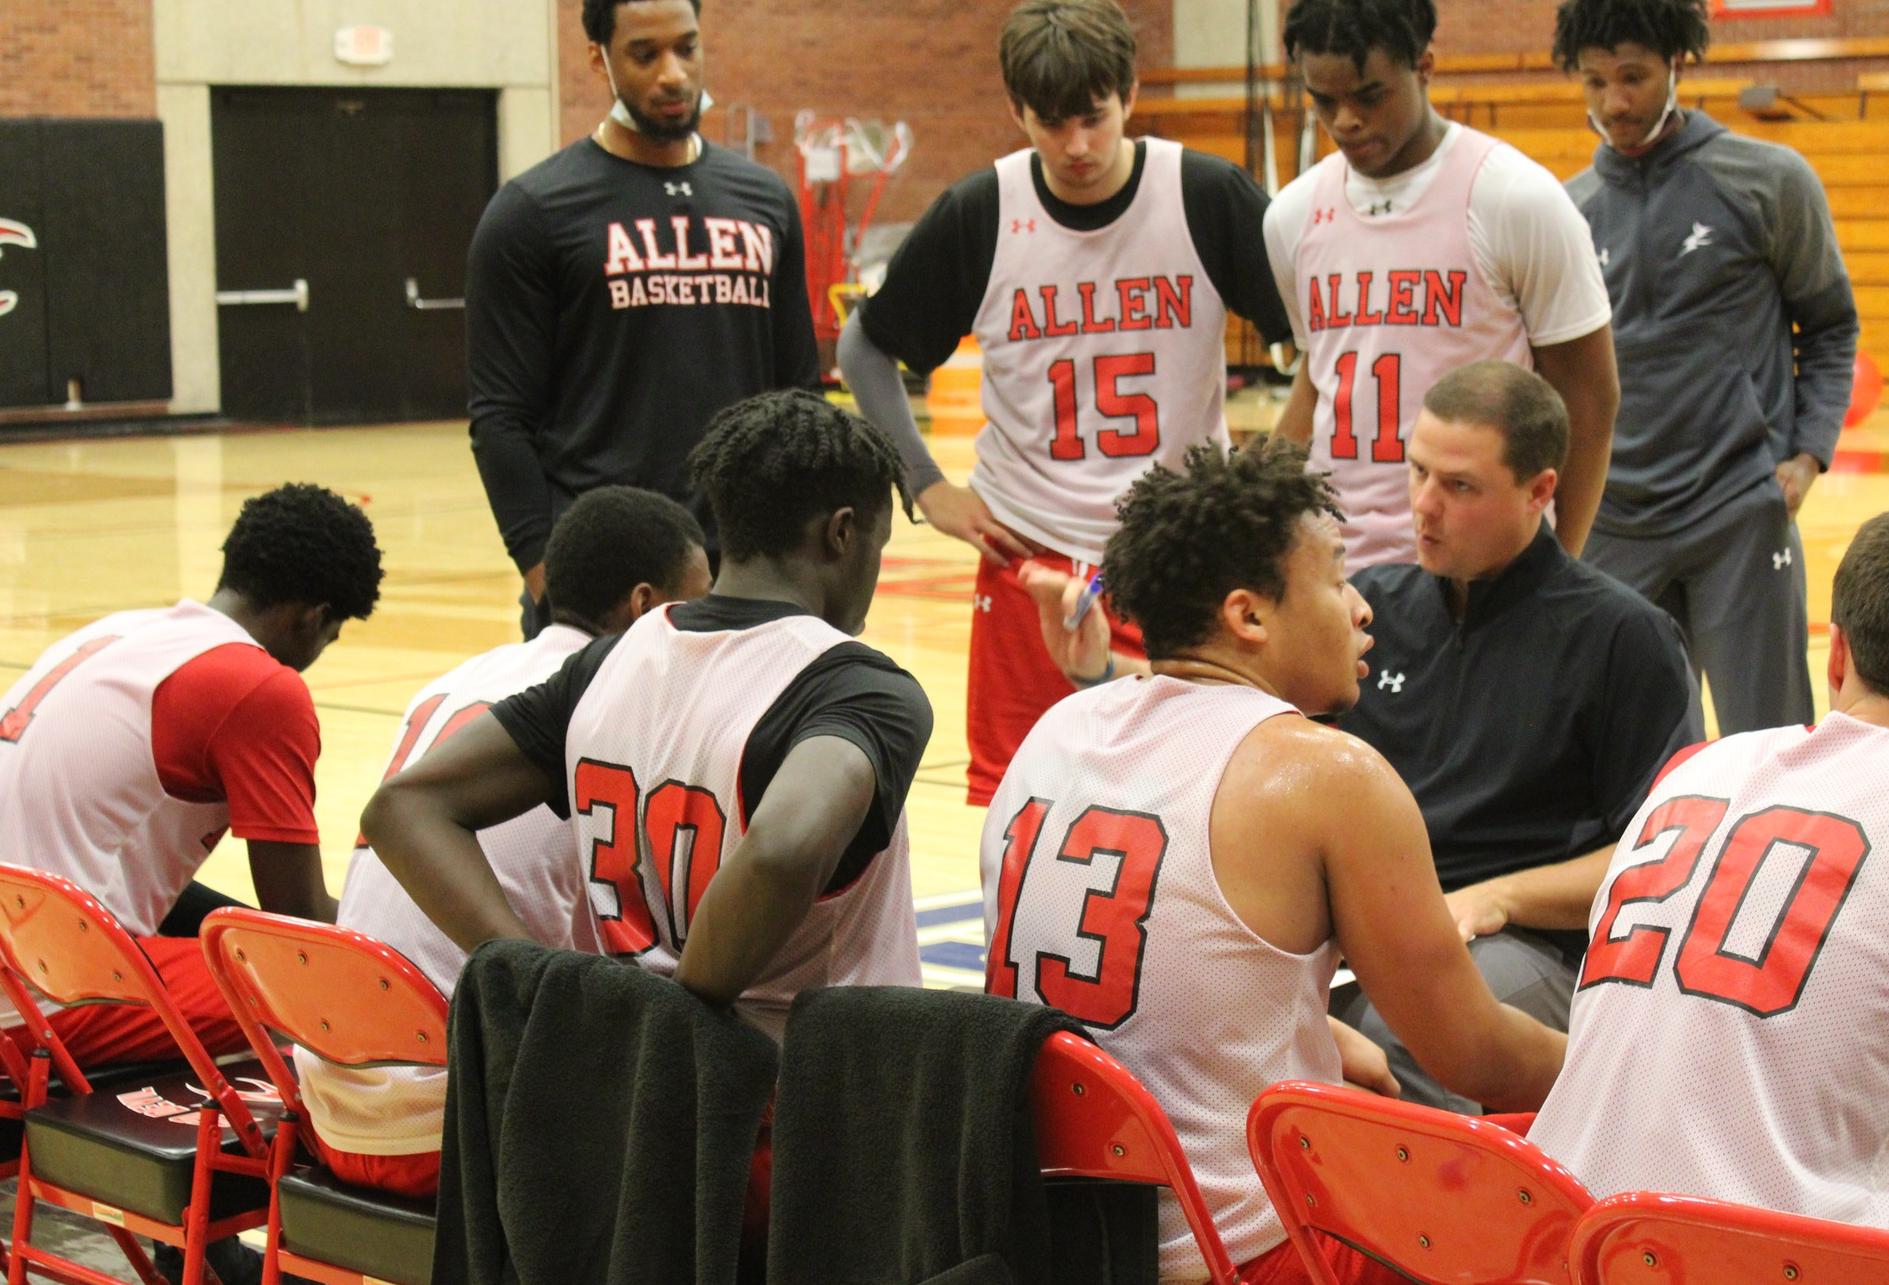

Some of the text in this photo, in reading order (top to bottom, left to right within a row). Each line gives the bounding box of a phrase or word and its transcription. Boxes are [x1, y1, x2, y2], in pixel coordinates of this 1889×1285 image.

[604, 215, 773, 276] ALLEN
[1007, 275, 1193, 342] ALLEN
[1309, 270, 1467, 333] ALLEN
[1047, 352, 1160, 461] 15
[1331, 351, 1405, 463] 11
[574, 757, 727, 957] 30
[1577, 794, 1872, 1018] 20
[984, 795, 1169, 1030] 13
